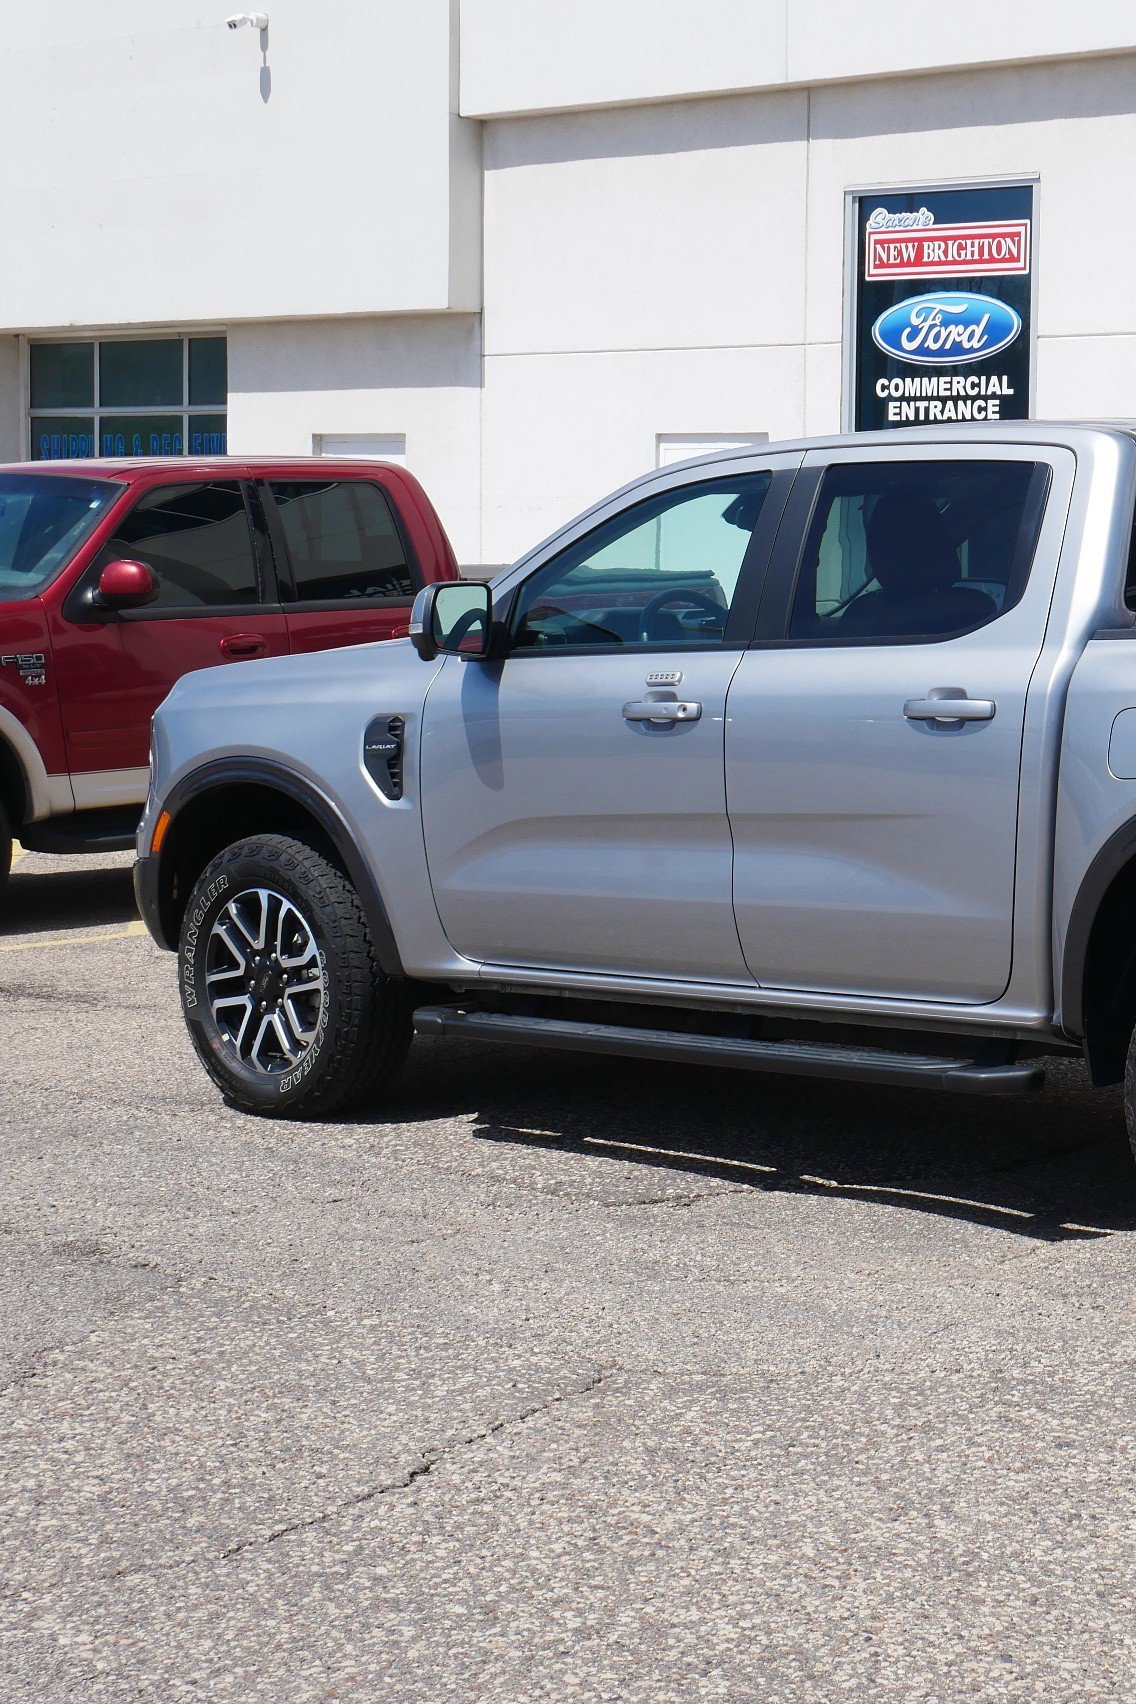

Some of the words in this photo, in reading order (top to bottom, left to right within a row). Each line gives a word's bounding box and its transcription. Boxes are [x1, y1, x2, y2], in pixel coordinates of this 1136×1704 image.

[869, 208, 932, 230] Saxon's
[874, 242, 918, 265] NEW
[922, 236, 1020, 263] BRIGHTON
[901, 302, 992, 351] Ford
[875, 375, 1014, 398] COMMERCIAL
[888, 399, 1001, 421] ENTRANCE
[181, 874, 229, 1008] WRANGLER
